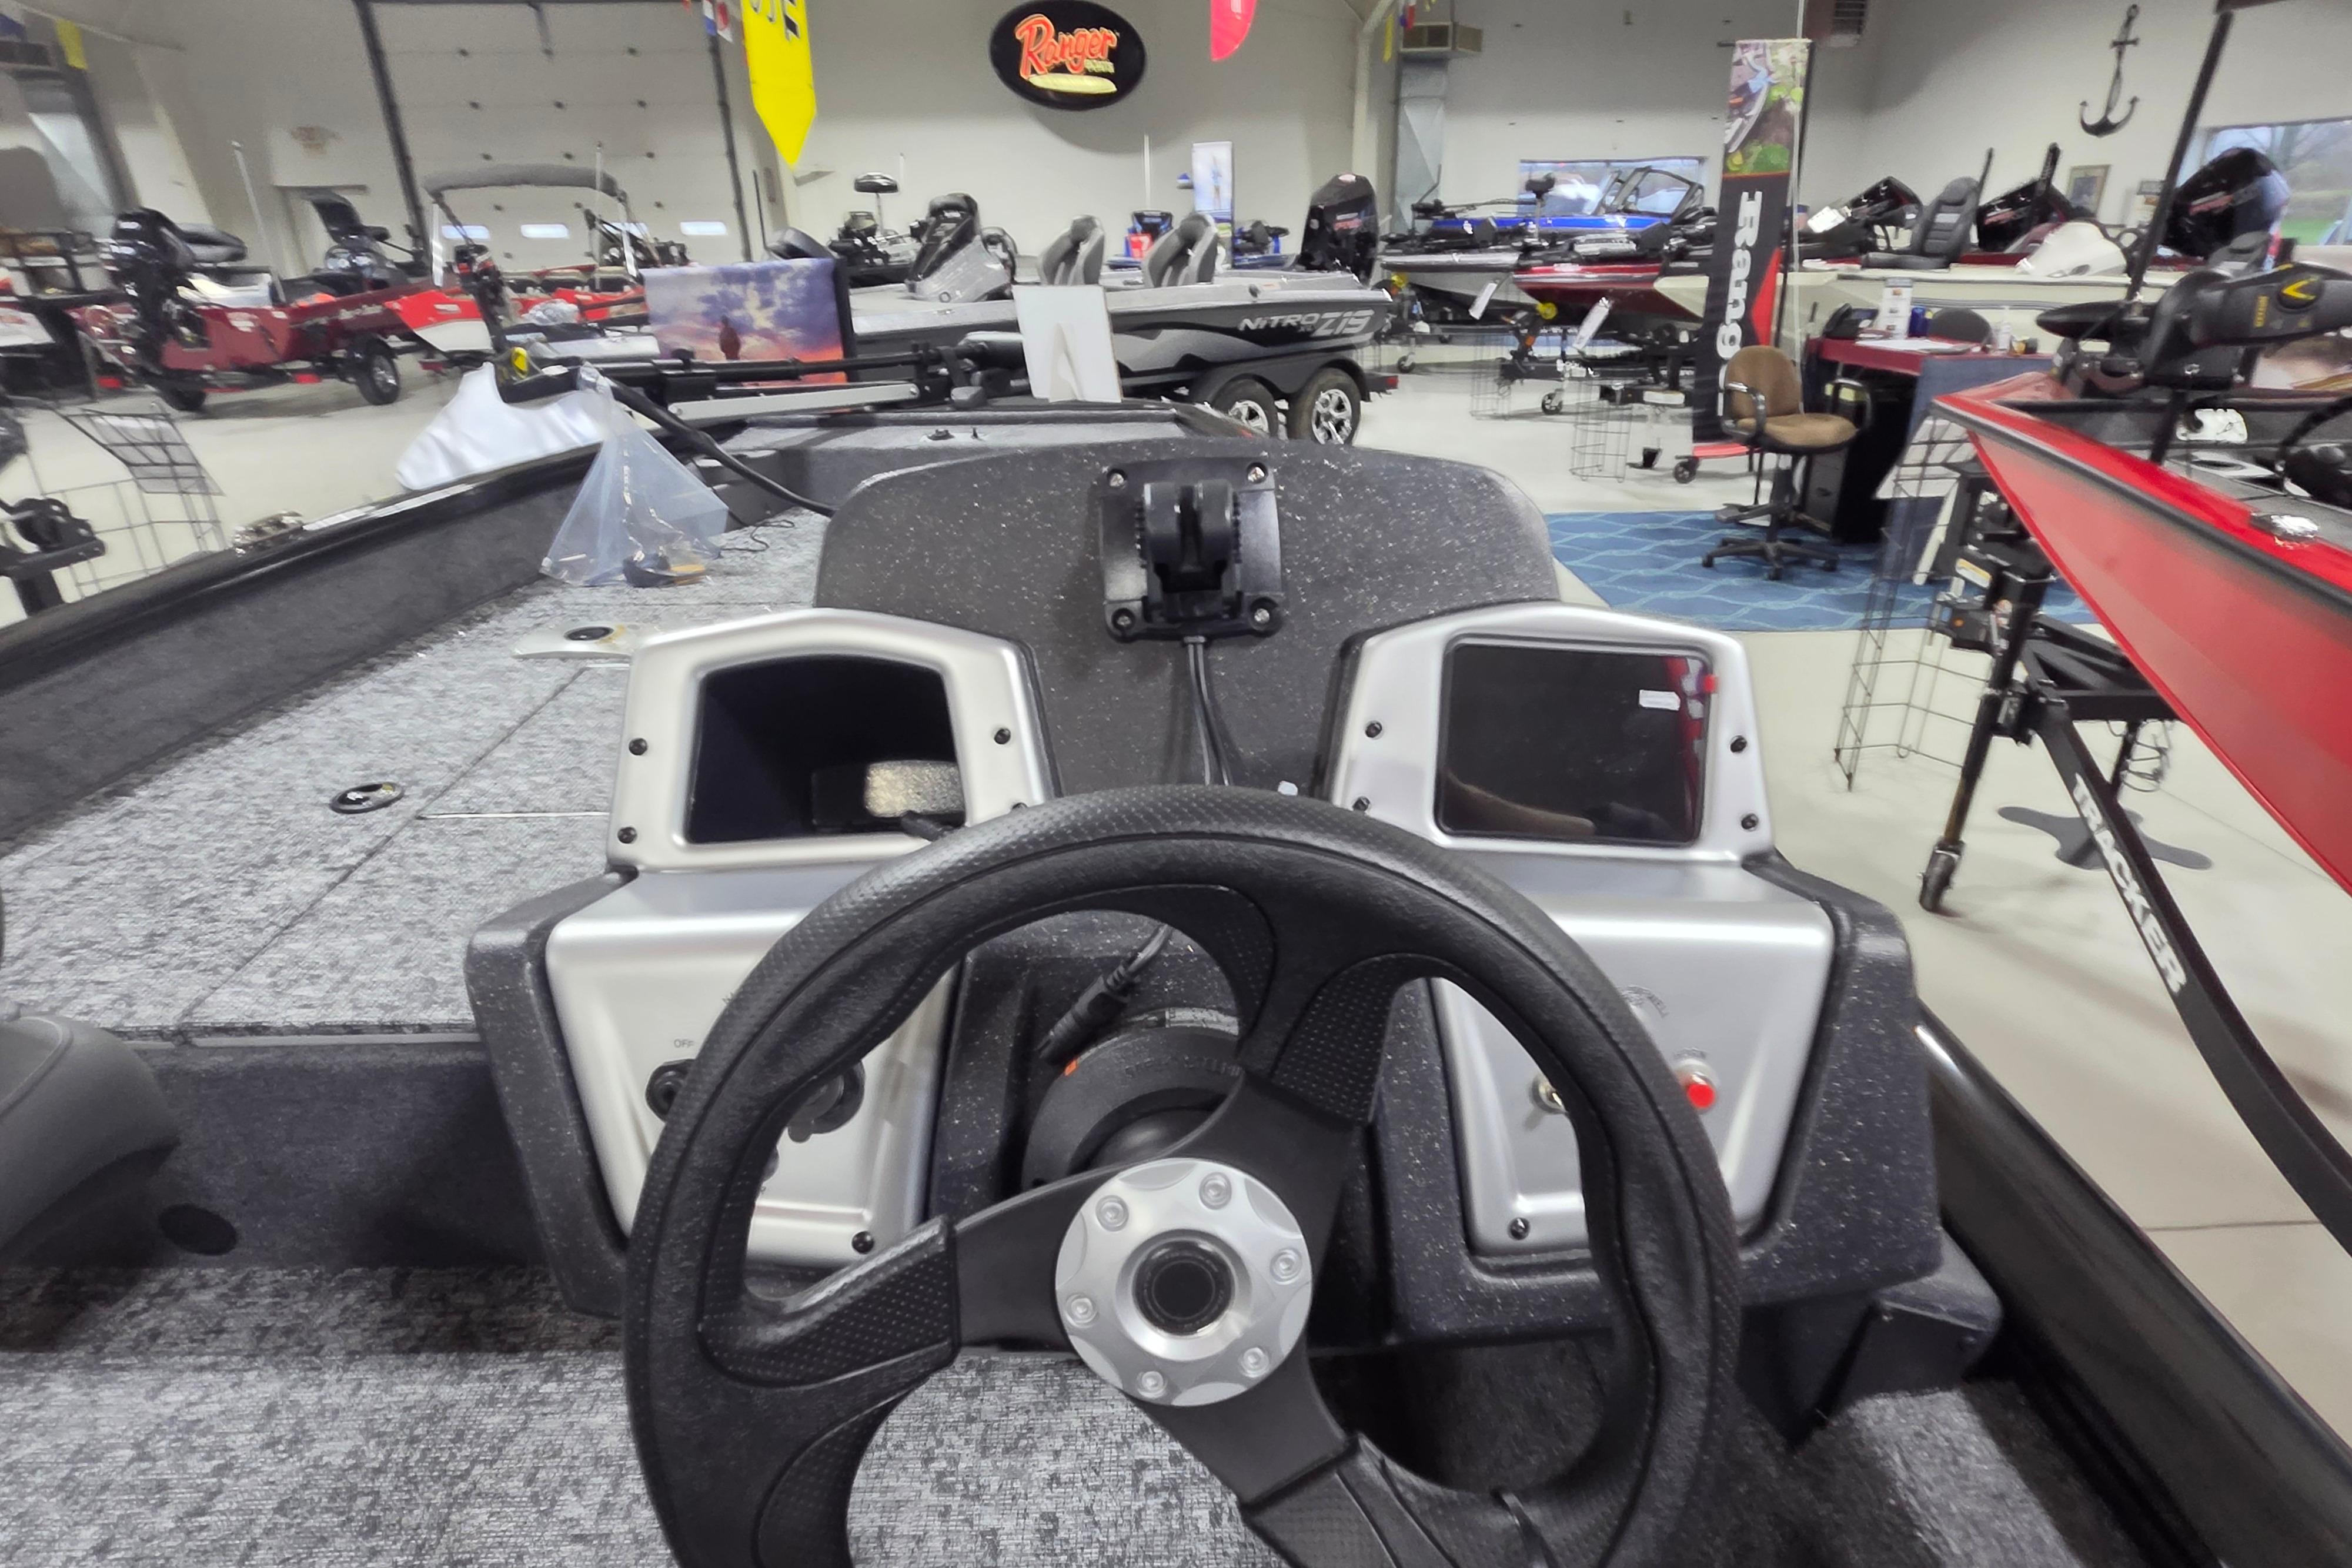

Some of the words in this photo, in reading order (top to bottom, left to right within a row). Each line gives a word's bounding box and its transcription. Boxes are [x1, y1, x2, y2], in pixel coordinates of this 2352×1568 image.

[1015, 13, 1117, 80] Ranger
[2073, 772, 2187, 994] TRACKER
[673, 1038, 695, 1048] OFF
